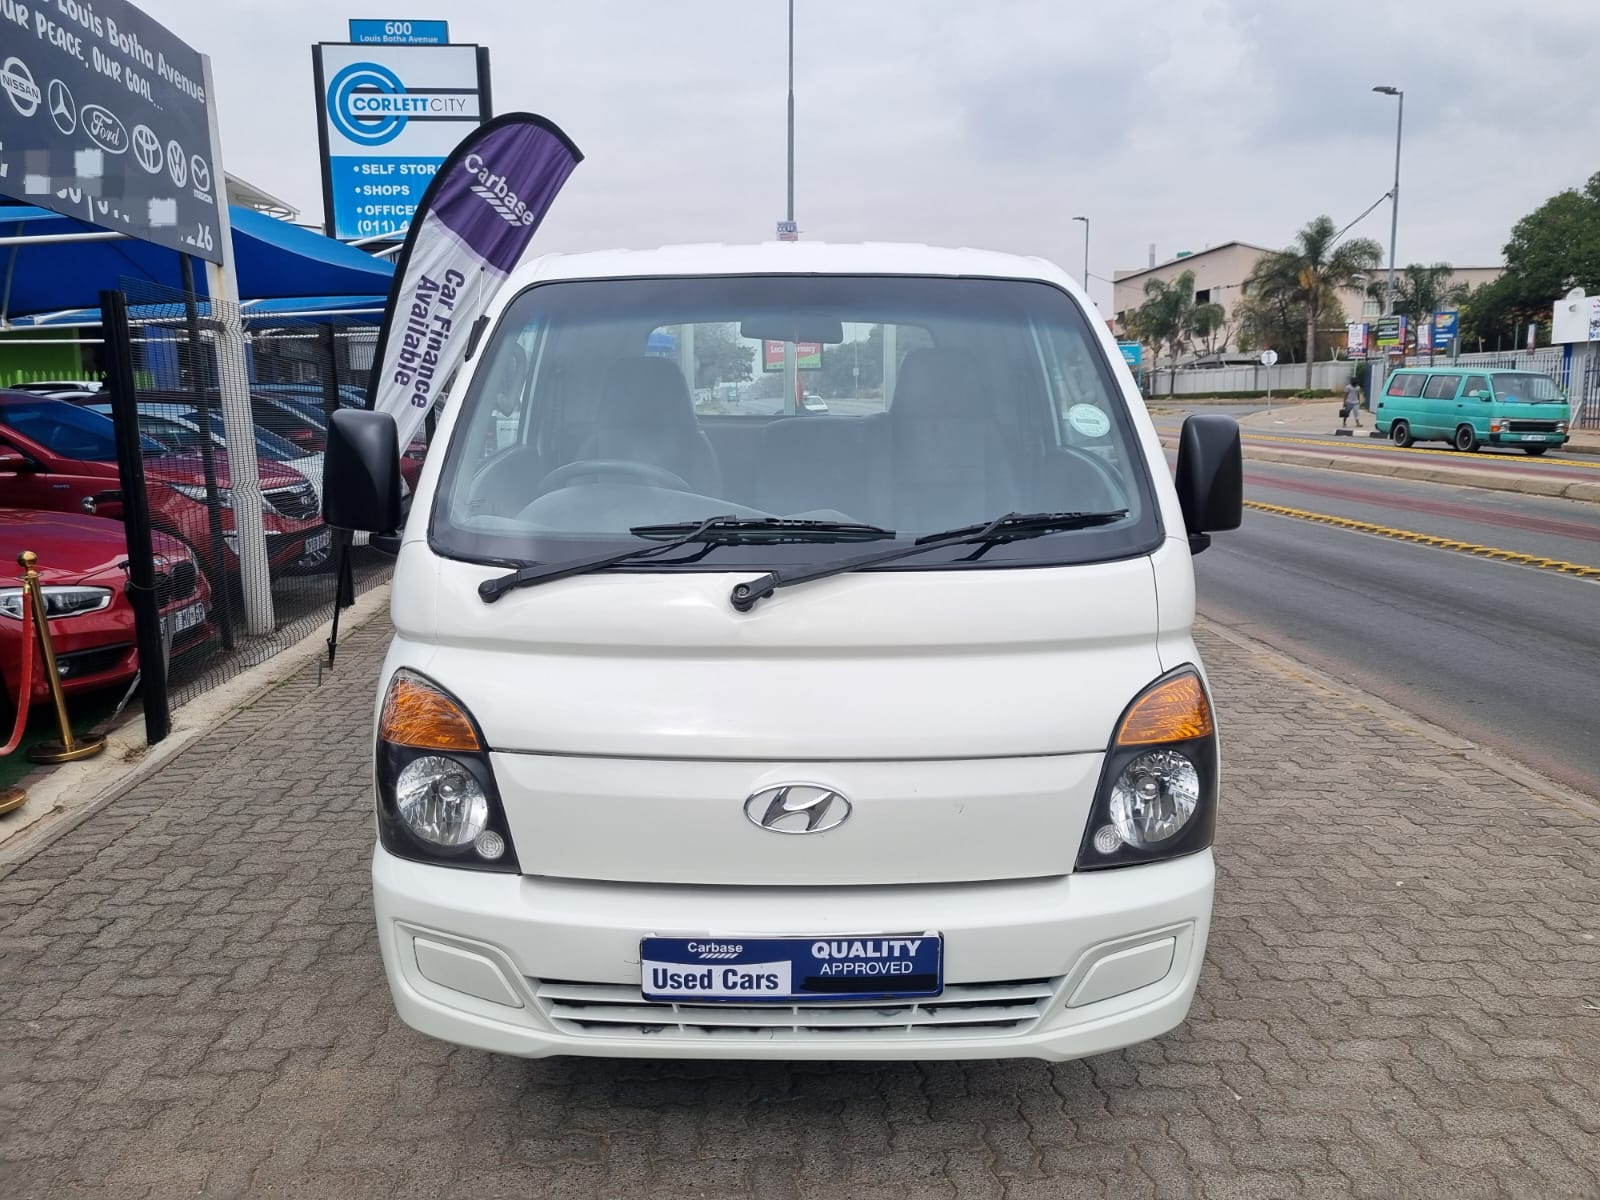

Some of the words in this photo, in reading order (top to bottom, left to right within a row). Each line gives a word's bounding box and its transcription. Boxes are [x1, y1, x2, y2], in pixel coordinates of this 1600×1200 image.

[360, 34, 381, 42] Louis
[385, 22, 412, 35] 600
[0, 0, 29, 30] UR
[92, 46, 122, 83] OUR
[58, 0, 103, 37] Louis
[107, 18, 154, 70] Botha
[158, 53, 206, 103] Avenue
[2, 74, 39, 98] NISSAN
[91, 111, 119, 146] Ford
[362, 164, 395, 174] SELF
[363, 185, 410, 196] SHOPS
[464, 154, 535, 226] Carbase
[357, 220, 395, 234] (011)
[438, 269, 465, 311] Car
[394, 275, 441, 387] Available
[411, 315, 453, 410] Finance
[687, 942, 744, 954] Carbase
[811, 940, 922, 959] QUALITY
[652, 967, 713, 990] Used
[722, 968, 779, 990] Cars
[820, 961, 913, 976] APPROVED
